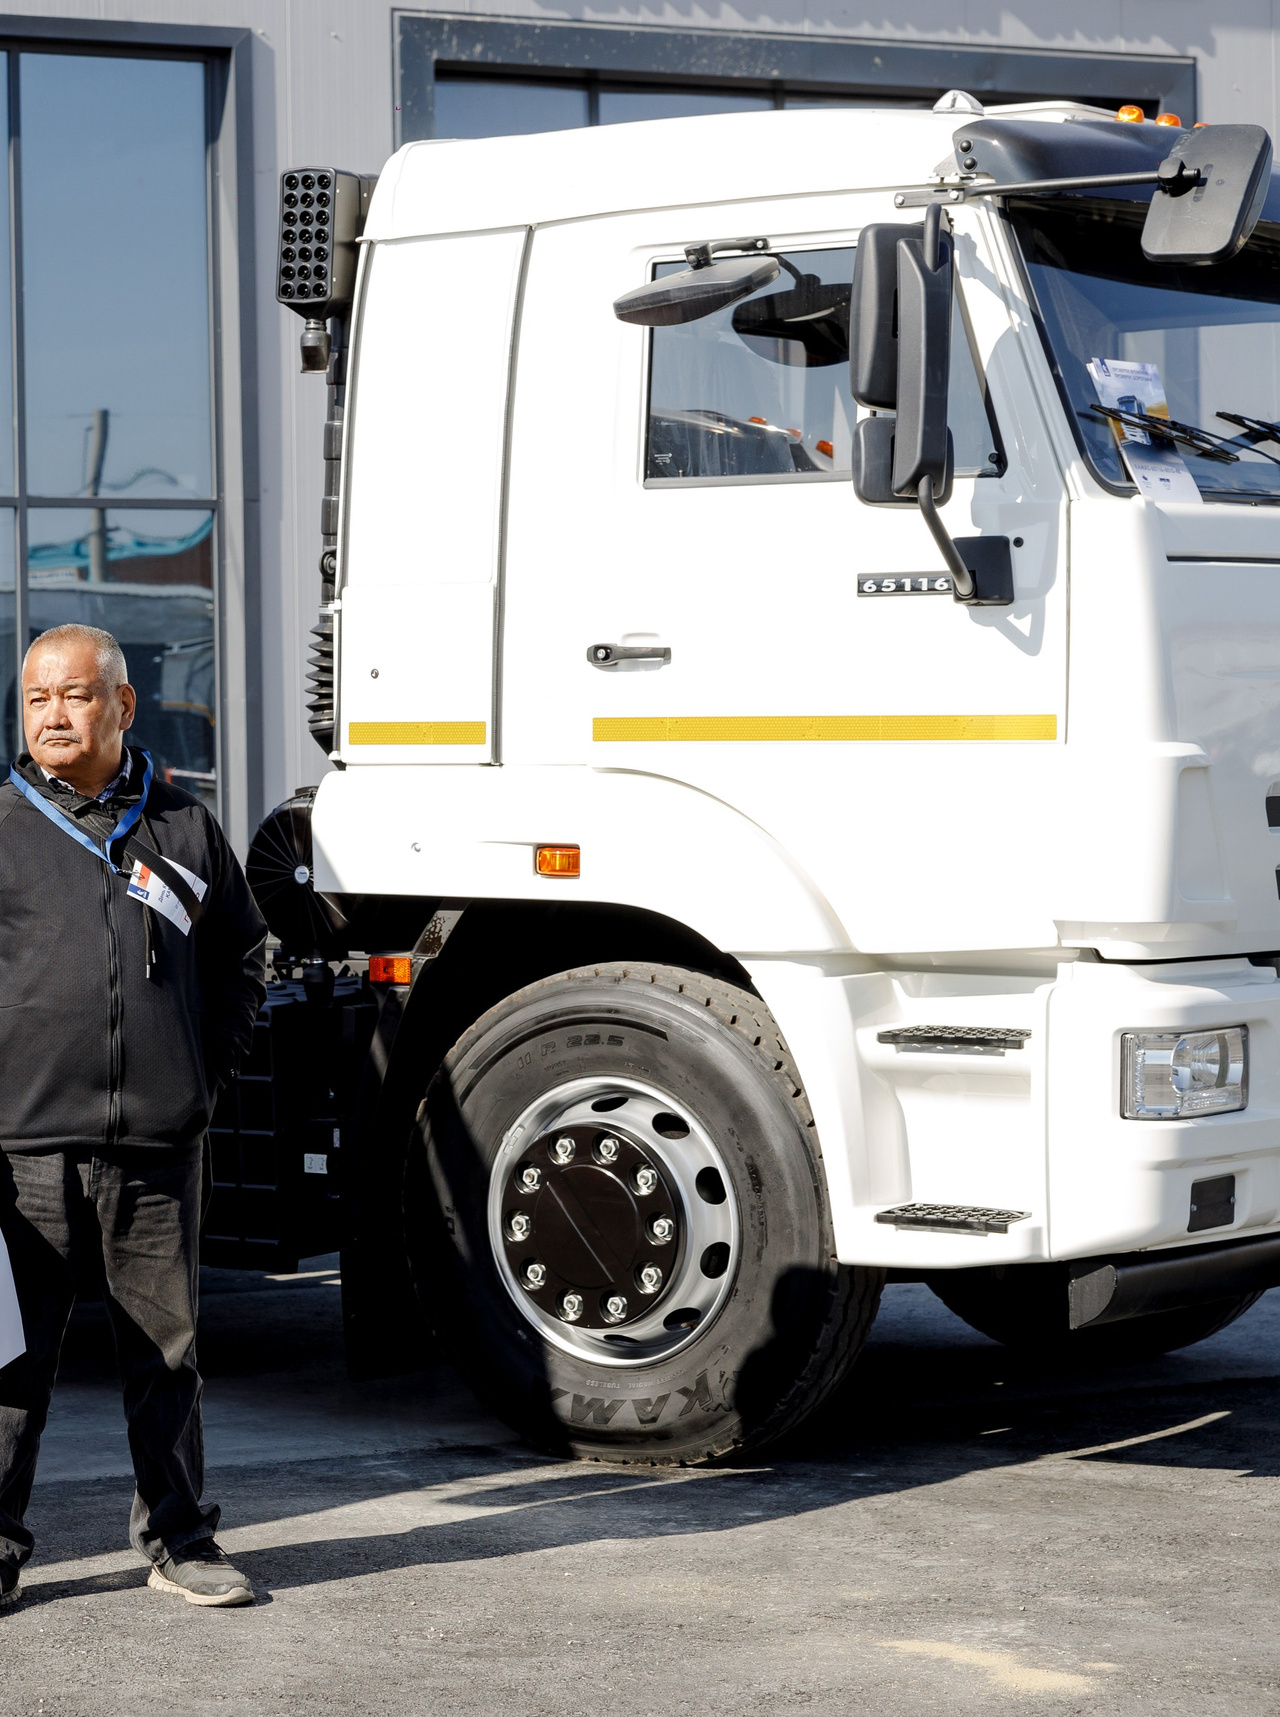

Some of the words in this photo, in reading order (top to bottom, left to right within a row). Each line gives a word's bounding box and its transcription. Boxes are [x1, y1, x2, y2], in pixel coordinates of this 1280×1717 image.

[862, 577, 950, 593] 65116
[540, 1041, 557, 1057] R
[566, 1033, 625, 1048] 22.5
[585, 1379, 620, 1389] TUBELESS
